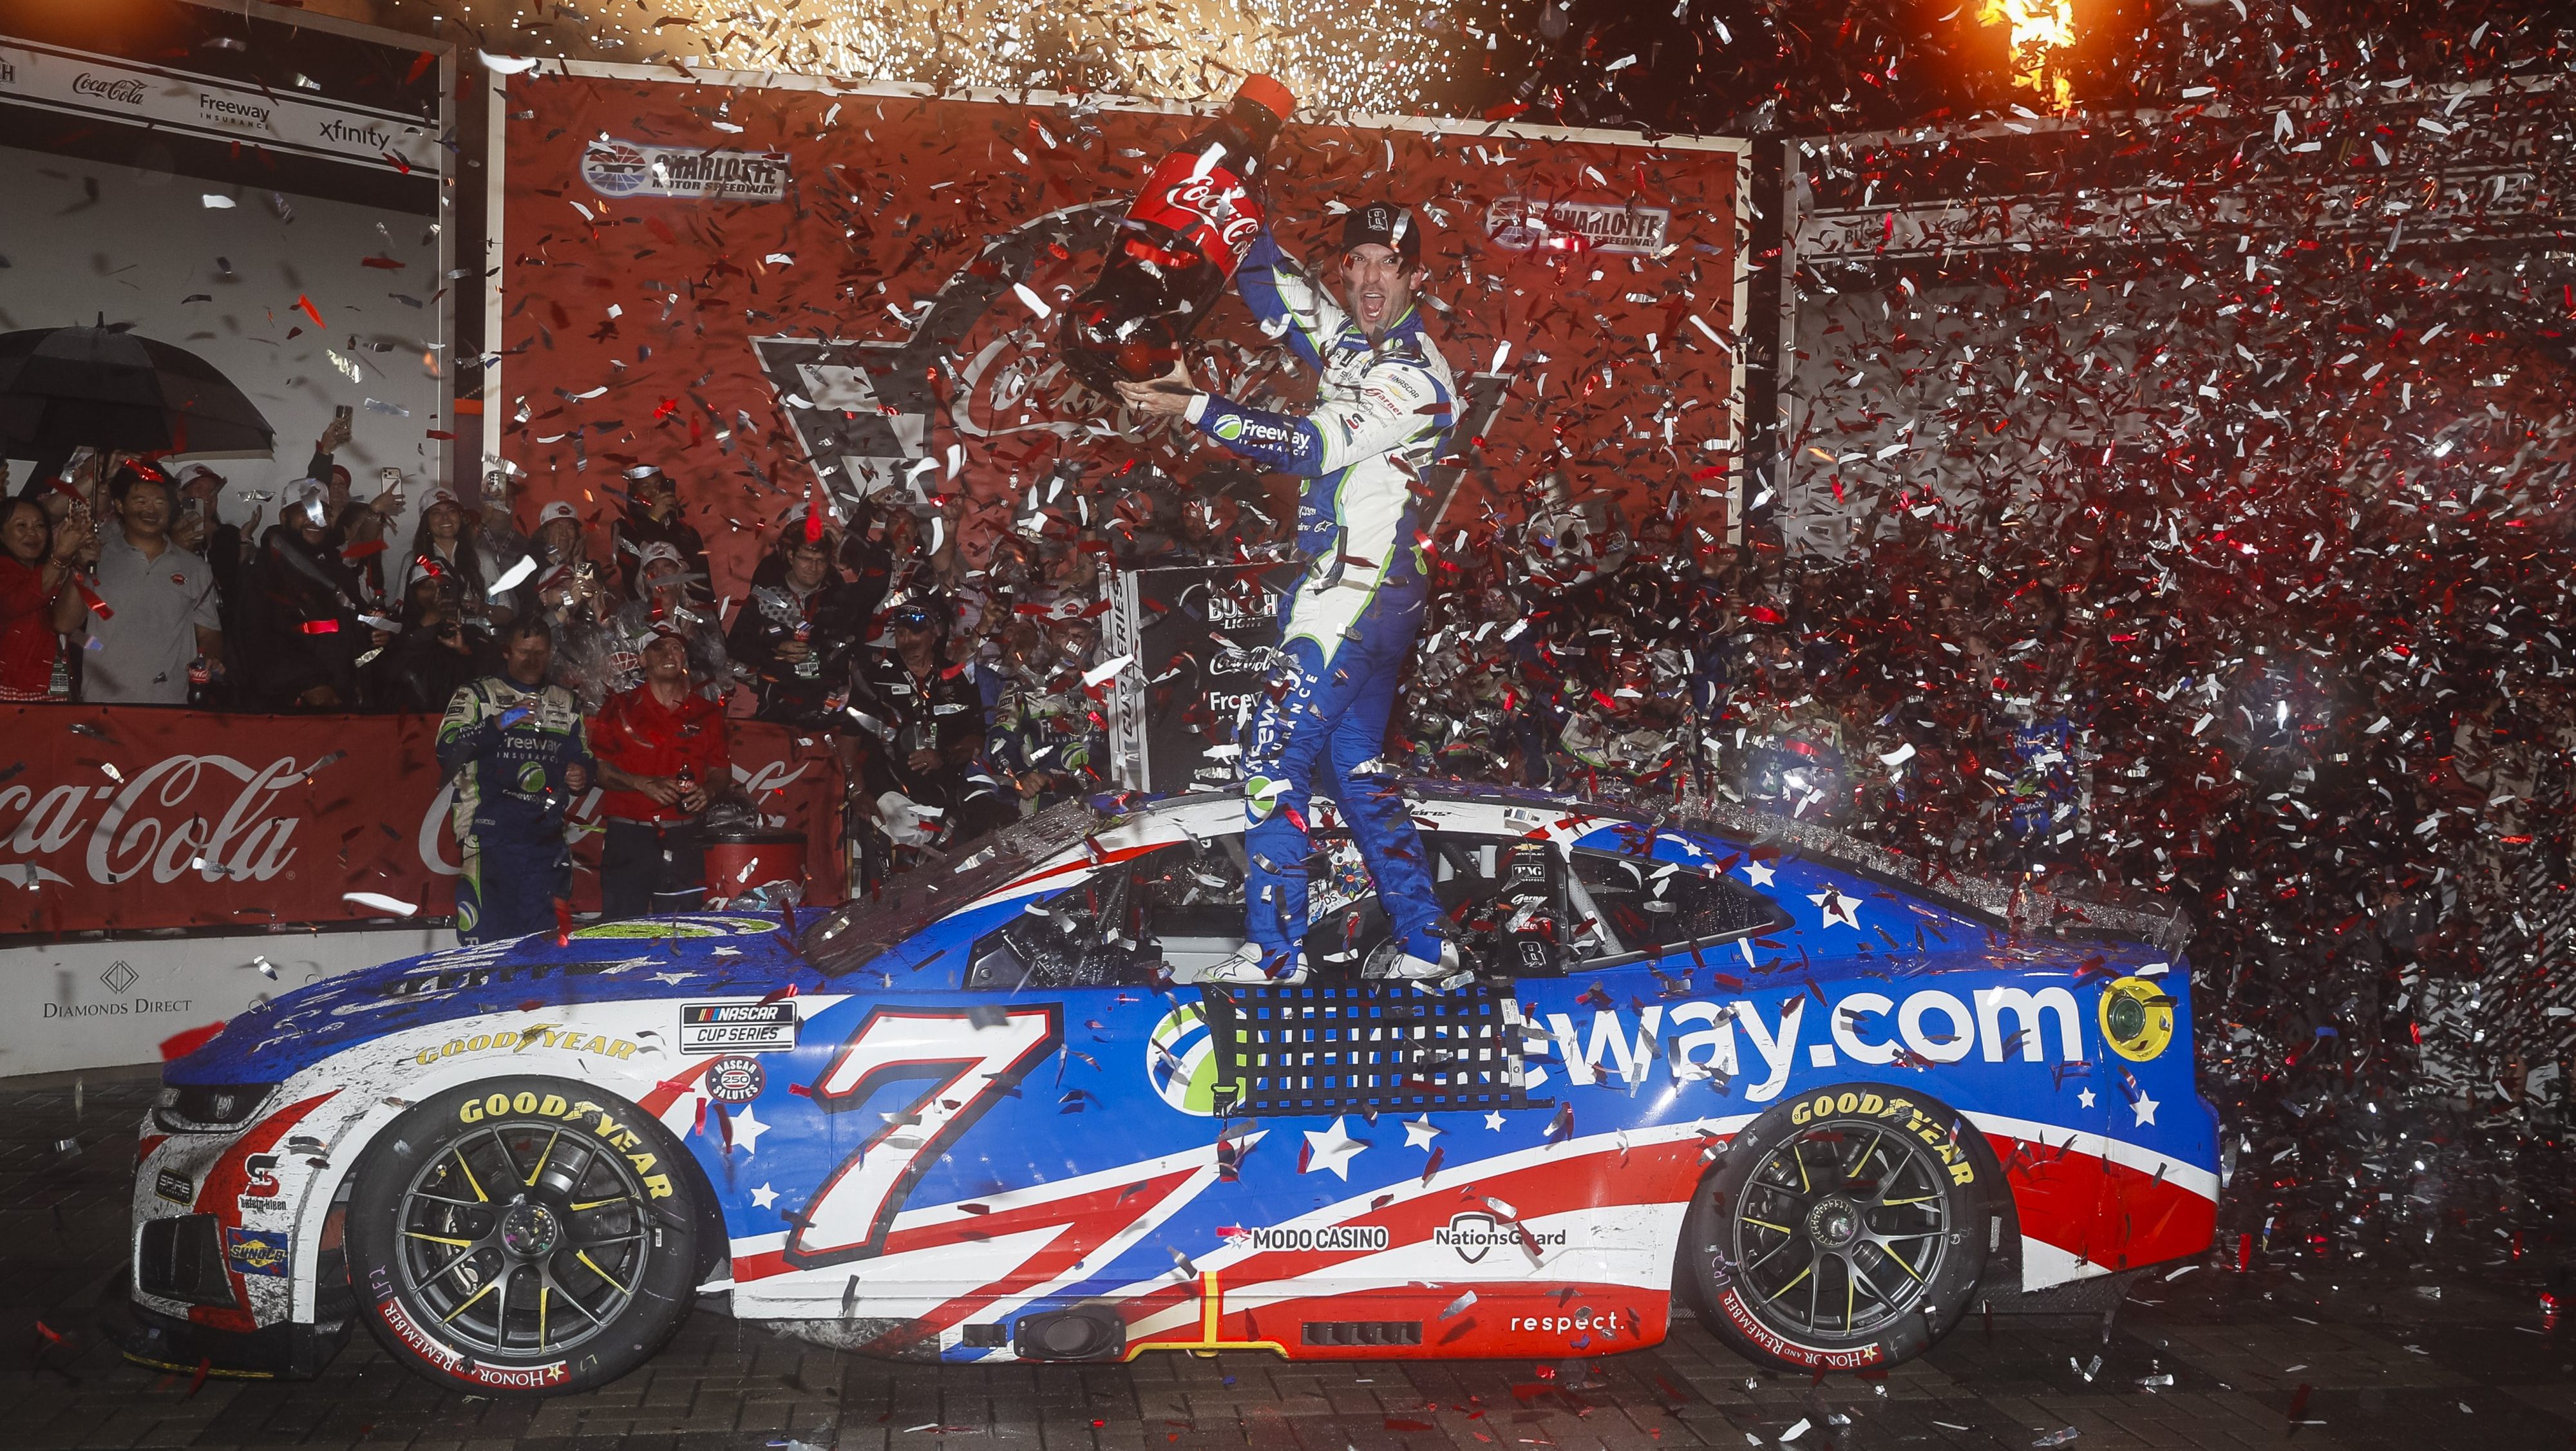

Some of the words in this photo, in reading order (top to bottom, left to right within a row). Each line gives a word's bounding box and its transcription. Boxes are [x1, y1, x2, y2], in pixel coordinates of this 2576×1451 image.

[73, 73, 147, 105] Coca-Cola
[200, 94, 269, 122] Freeway
[319, 120, 390, 151] xfinity
[1394, 375, 1420, 399] NASCAR
[1363, 388, 1403, 416] Garner
[1112, 577, 1132, 676] ERIES
[504, 733, 562, 754] reeway
[0, 755, 330, 887] ca-Cola
[43, 1002, 128, 1018] DIAMONDS
[135, 998, 192, 1014] DIRECT
[717, 1006, 779, 1021] NASCAR
[697, 1029, 726, 1042] CUP
[728, 1027, 779, 1041] SERIES
[714, 1059, 757, 1074] NASCAR
[723, 1076, 750, 1084] 250
[713, 1084, 759, 1100] SALUTES
[783, 1001, 1064, 1271] 7
[1253, 1229, 1311, 1249] MODO
[1316, 1228, 1387, 1249] CASINO
[1435, 1229, 1566, 1246] NationsGard
[1723, 1292, 1784, 1356] REMEMBER
[383, 1302, 462, 1372] REMEMBER
[479, 1369, 545, 1387] HONOR
